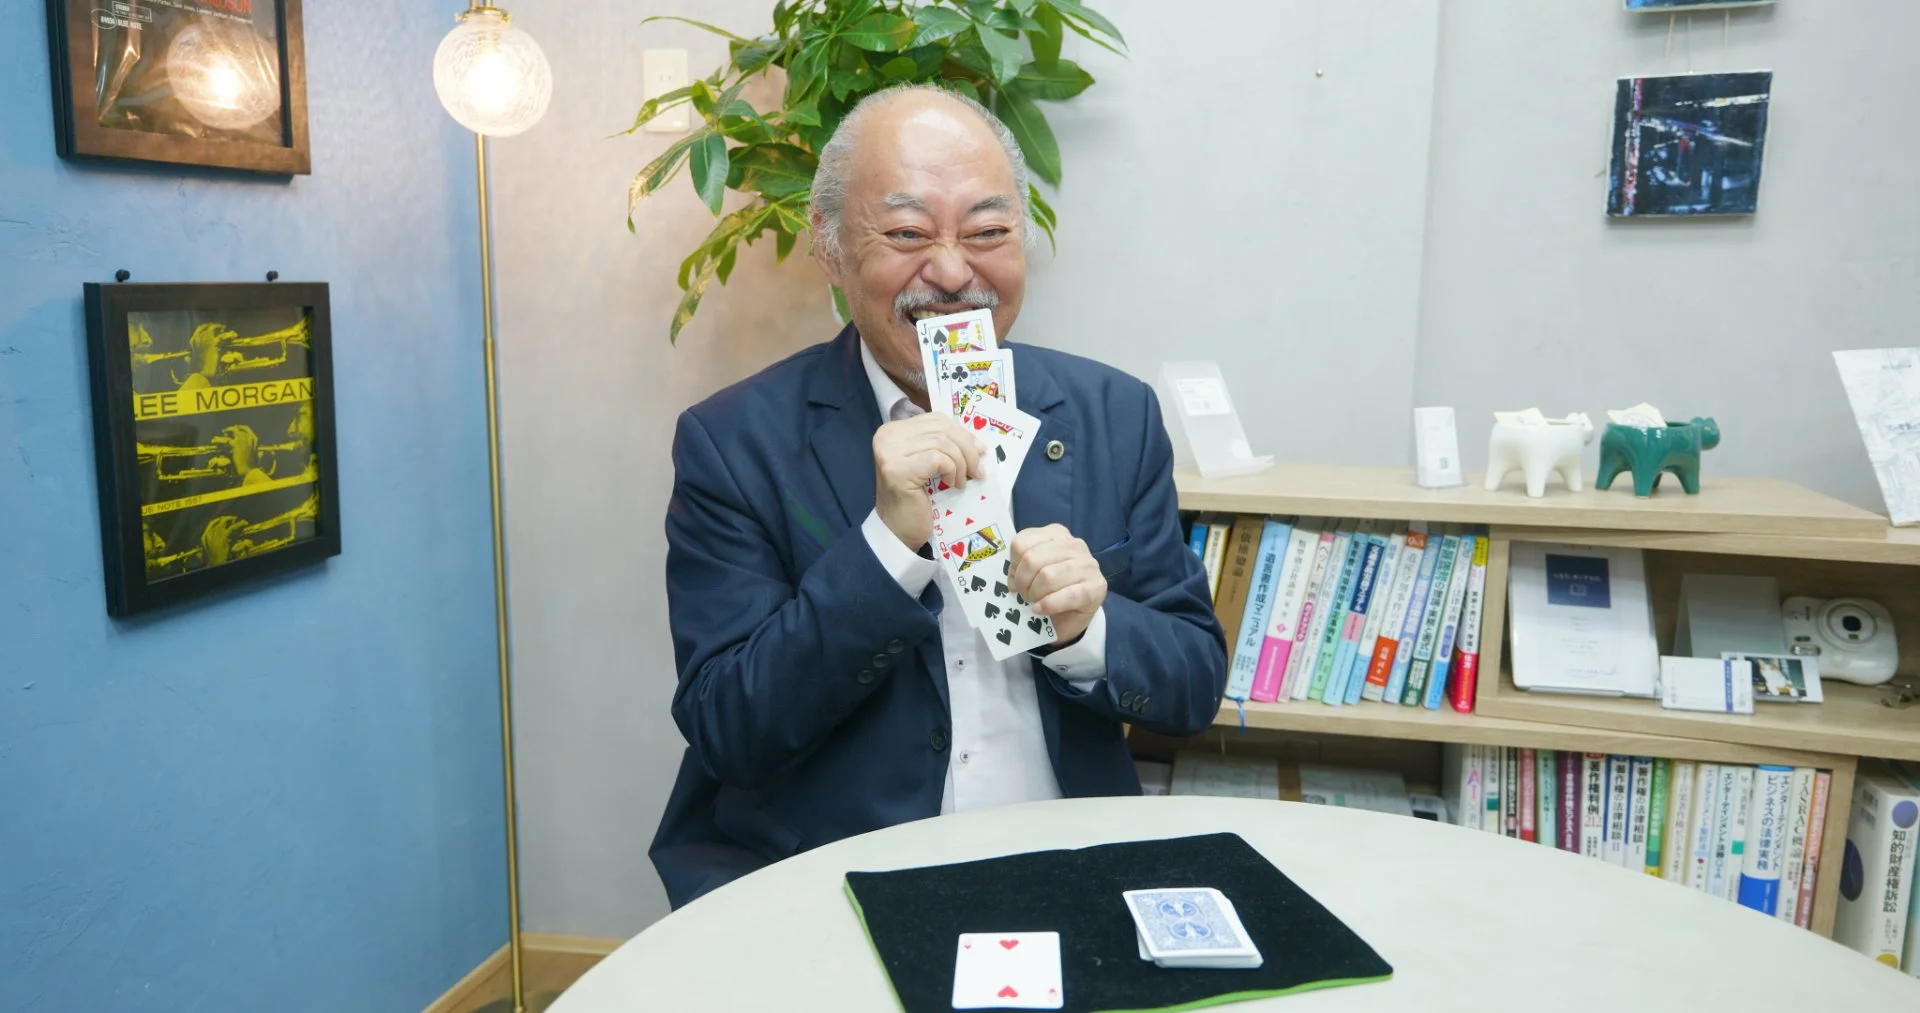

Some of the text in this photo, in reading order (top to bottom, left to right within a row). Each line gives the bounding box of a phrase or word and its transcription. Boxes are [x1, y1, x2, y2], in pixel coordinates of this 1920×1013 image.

[920, 323, 927, 336] J
[940, 359, 949, 371] K
[134, 382, 314, 417] EE MORGAN
[966, 405, 976, 416] J
[157, 501, 182, 511] NOTE
[958, 576, 967, 587] 8
[1045, 625, 1054, 638] 8
[1611, 764, 1625, 840] 著作権の法律相談
[1632, 767, 1648, 843] 著作権の法律相談
[1756, 775, 1778, 871] ビジネスの法律実務
